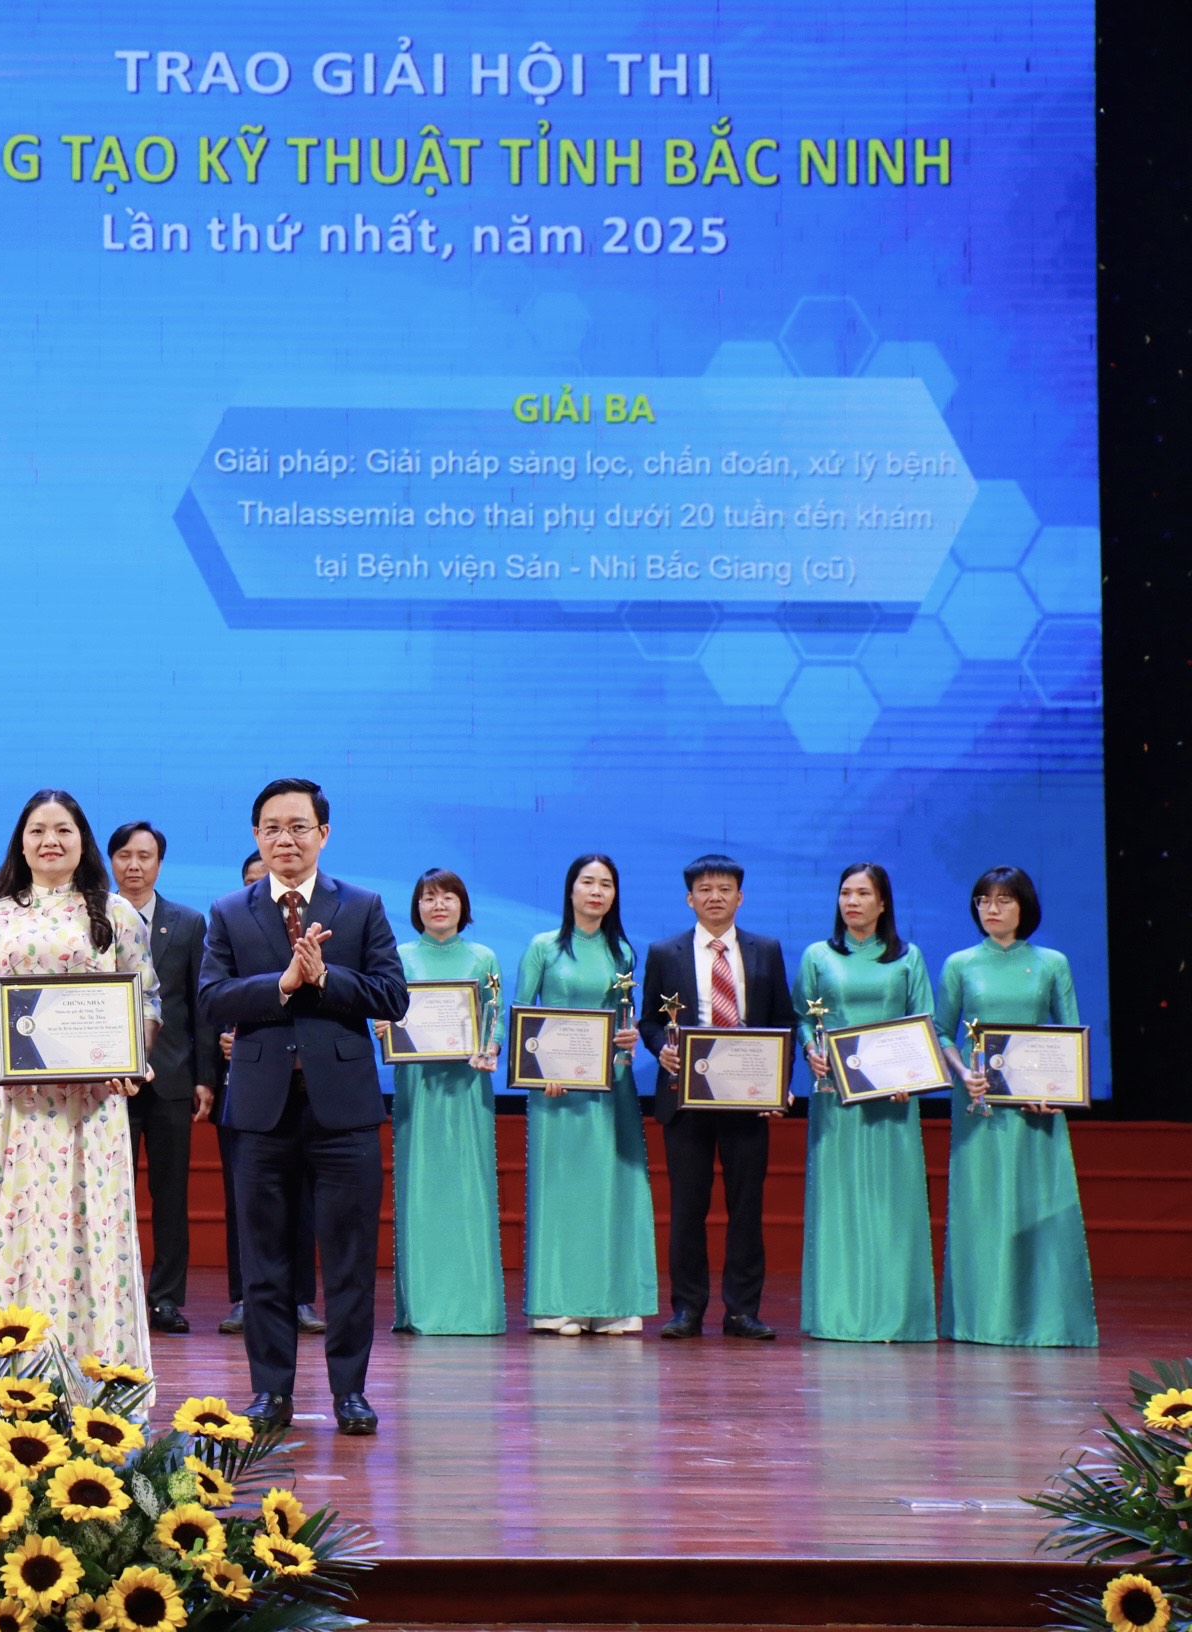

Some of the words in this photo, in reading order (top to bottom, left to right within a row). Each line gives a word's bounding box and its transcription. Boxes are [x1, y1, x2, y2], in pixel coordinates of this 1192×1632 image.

[114, 50, 291, 95] TRAO
[312, 36, 446, 96] GIẢI
[471, 41, 584, 106] HỘI
[607, 53, 712, 96] THI
[61, 134, 176, 194] TẠO
[199, 124, 269, 185] KỸ
[286, 124, 481, 197] THUẬT
[500, 119, 642, 186] TỈNH
[665, 116, 779, 187] BẮC
[799, 138, 951, 187] NINH
[102, 207, 189, 252] Lần
[207, 213, 303, 253] thứ
[320, 209, 454, 261] nhất,
[474, 216, 584, 254] năm
[602, 217, 727, 255] 2025
[513, 384, 591, 423] GIẢI
[605, 393, 656, 423] BA
[214, 447, 269, 473] Giải
[279, 448, 356, 478] pháp:
[366, 448, 421, 474] Giải
[431, 449, 499, 479] pháp
[509, 450, 576, 480] sàng
[586, 451, 634, 480] lọc,
[643, 445, 710, 476] chẩn
[721, 450, 799, 478] đoán,
[809, 453, 844, 476] xử
[854, 451, 878, 482] lý
[886, 451, 957, 483] bệnh
[237, 500, 415, 527] Thalassemia
[424, 502, 475, 527] cho
[484, 503, 534, 528] thai
[544, 503, 595, 533] phụ
[605, 503, 671, 528] dưới
[679, 504, 714, 528] 20
[724, 503, 785, 529] tuần
[795, 500, 848, 529] đến
[856, 504, 934, 530] khám
[315, 553, 348, 582] tại
[357, 554, 429, 584] Bệnh
[439, 554, 496, 585] viện
[506, 553, 561, 579] Sản
[590, 555, 637, 579] Nhi
[646, 550, 701, 580] Bắc
[710, 555, 792, 586] Giang
[802, 556, 857, 587] (cũ)
